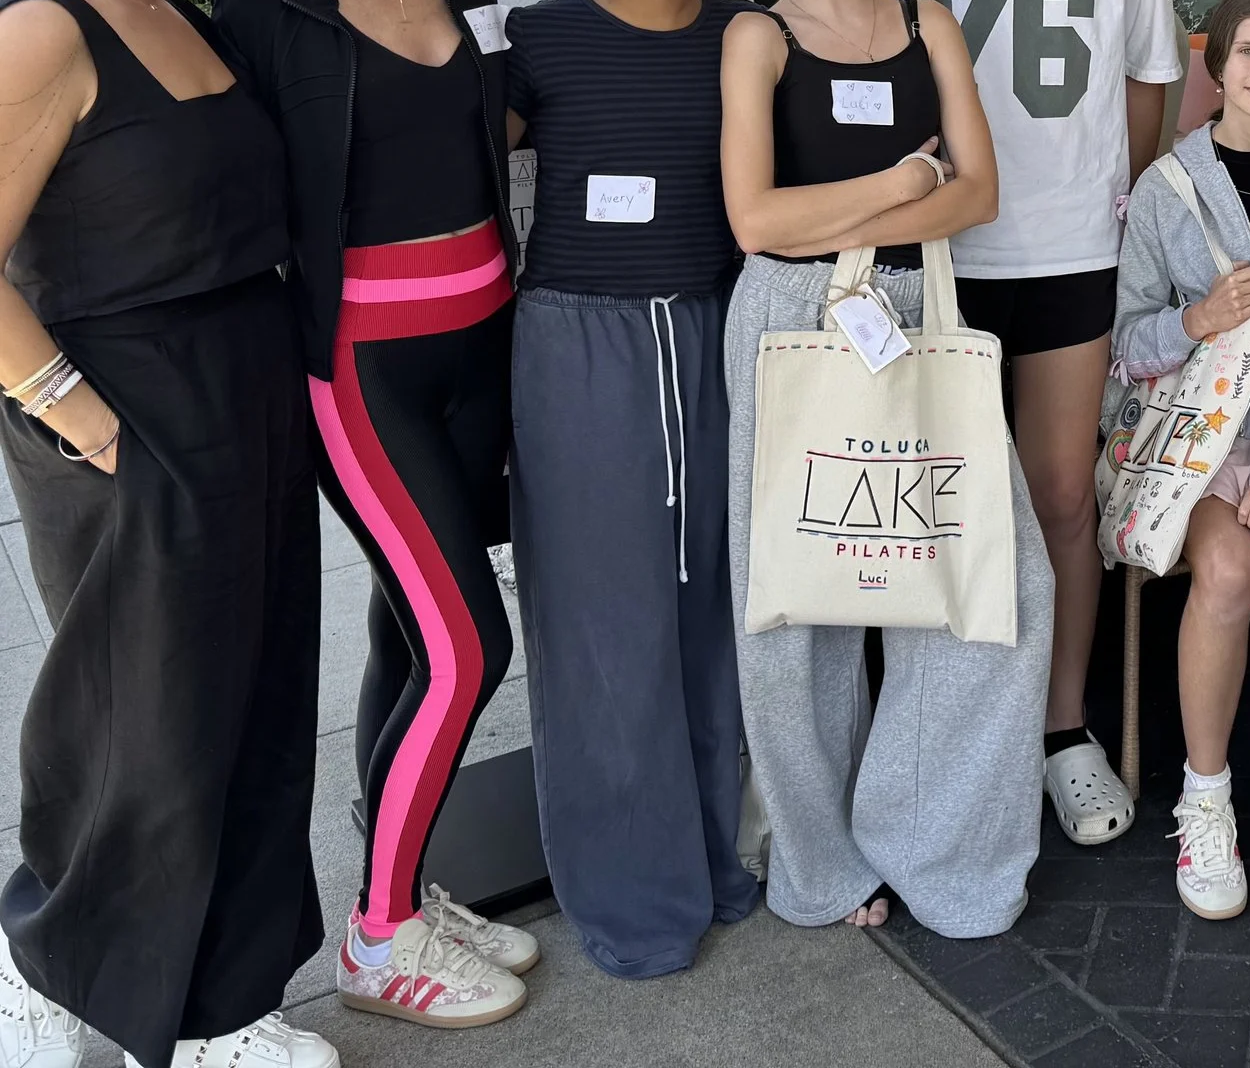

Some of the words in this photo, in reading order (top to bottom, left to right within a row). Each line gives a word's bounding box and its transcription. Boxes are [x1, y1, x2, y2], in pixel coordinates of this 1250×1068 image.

[841, 96, 870, 110] Luci
[599, 192, 635, 213] Avery
[845, 437, 930, 454] TOLUCA
[801, 459, 963, 530] LAKE
[836, 543, 937, 560] PILATES
[858, 569, 888, 585] Luci
